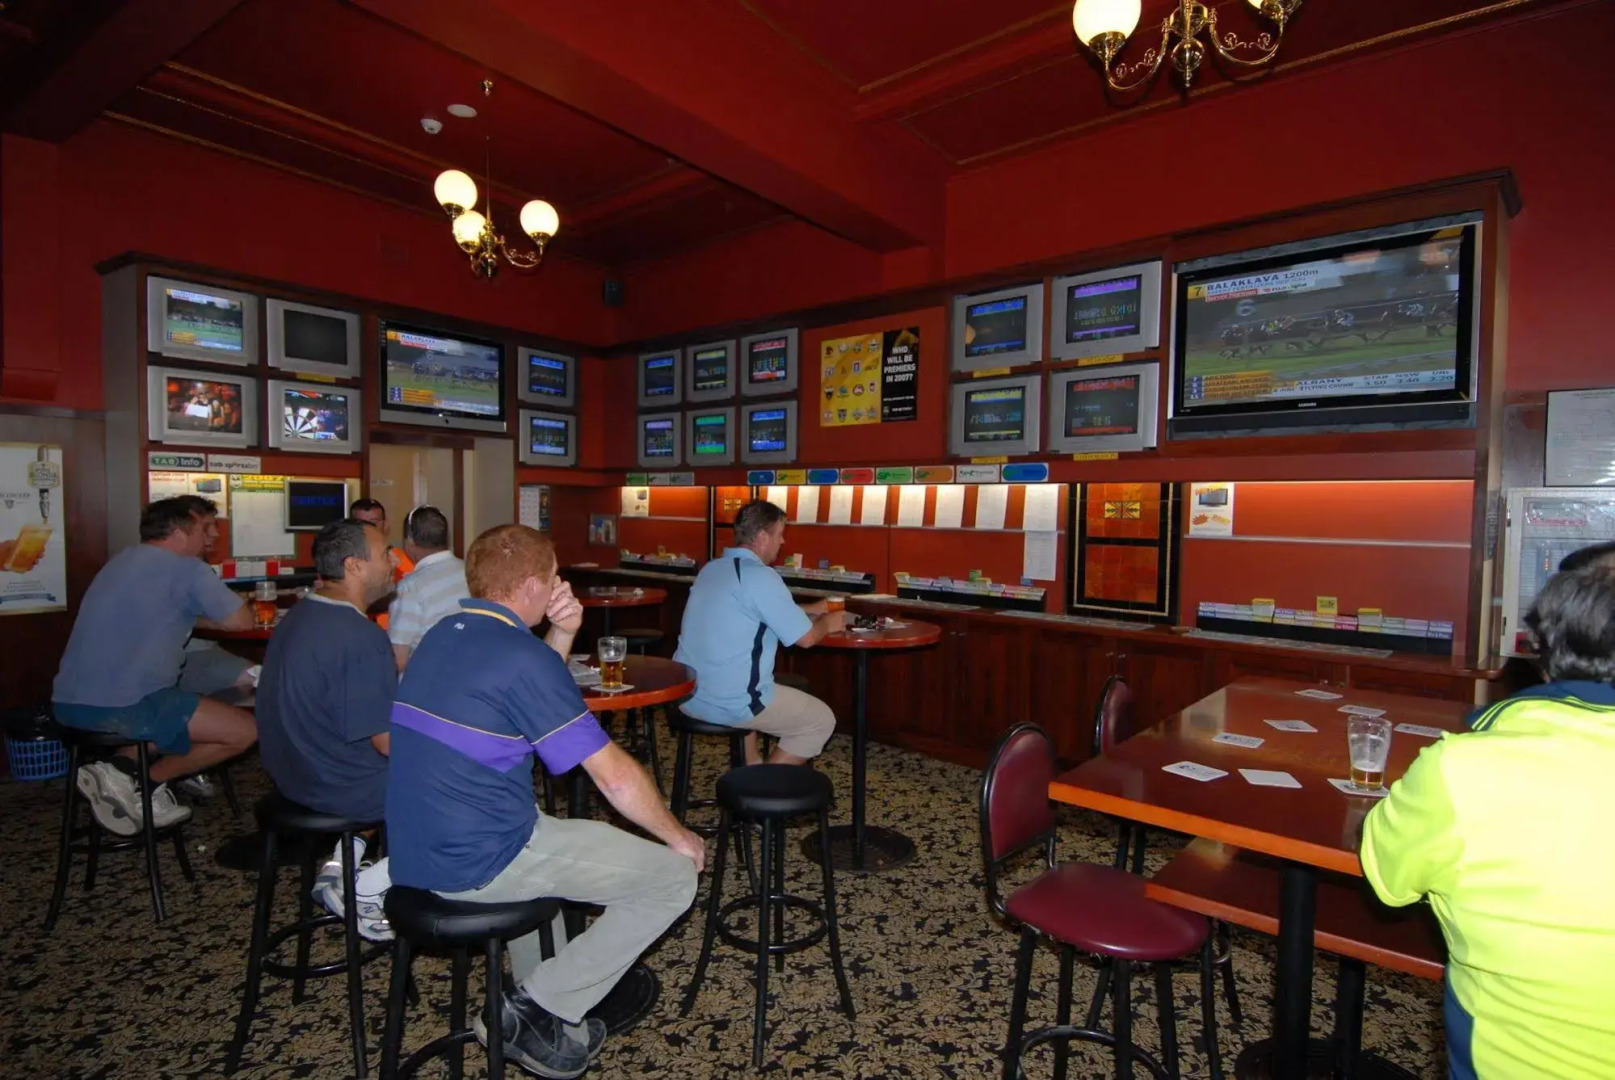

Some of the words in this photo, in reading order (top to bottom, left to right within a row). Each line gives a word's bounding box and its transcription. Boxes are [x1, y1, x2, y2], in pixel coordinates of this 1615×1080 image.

[1207, 274, 1280, 290] BALAKLAVA
[1284, 269, 1319, 280] 1200m
[892, 346, 908, 354] WHO
[887, 356, 902, 364] WILL
[884, 363, 916, 374] PREMIERS
[1296, 378, 1342, 387] ALBANY
[153, 458, 176, 466] TAB
